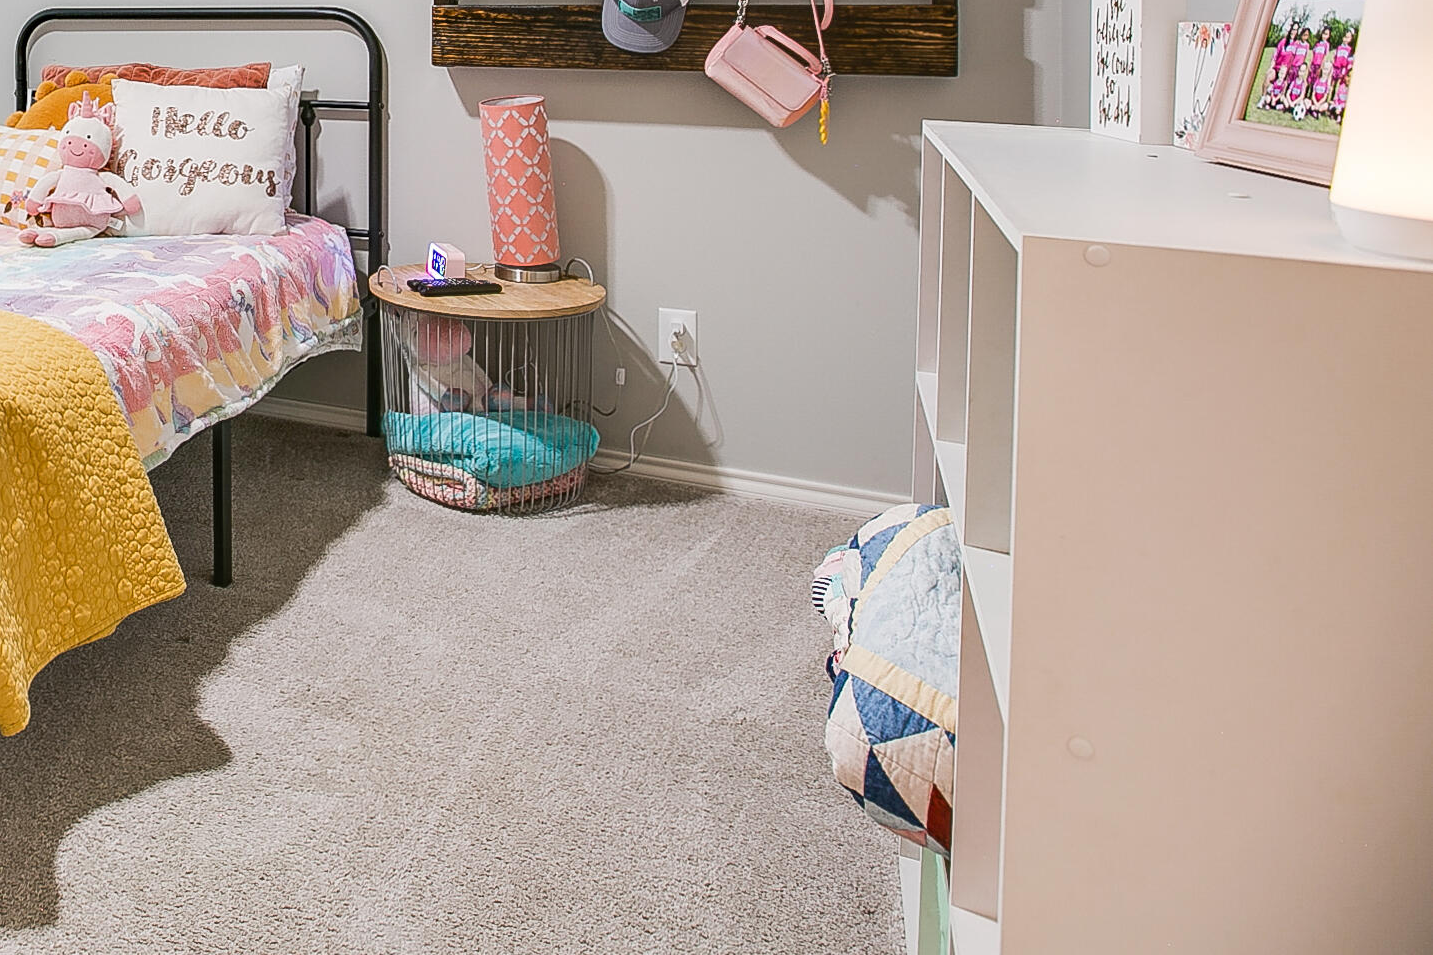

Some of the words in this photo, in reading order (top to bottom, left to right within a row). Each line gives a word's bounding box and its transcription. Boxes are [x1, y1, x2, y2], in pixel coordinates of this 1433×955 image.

[1105, 75, 1116, 99] so
[150, 106, 255, 141] Hello
[1113, 84, 1132, 128] did
